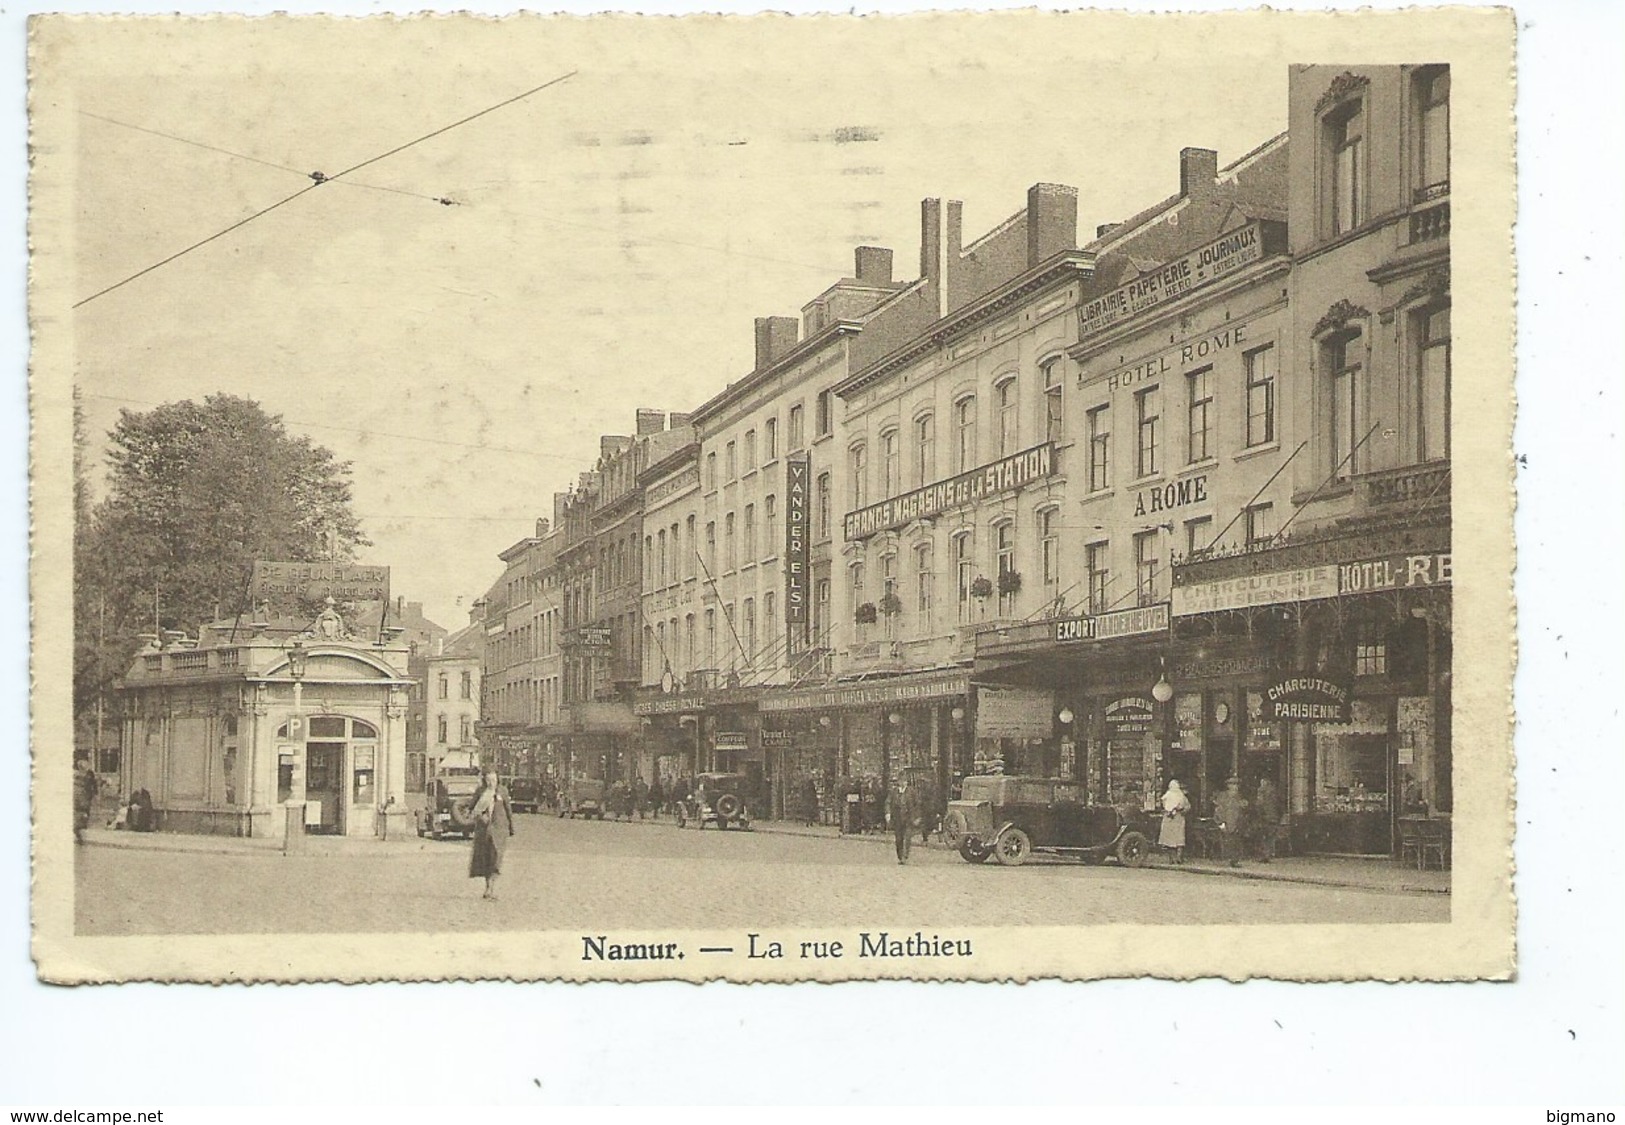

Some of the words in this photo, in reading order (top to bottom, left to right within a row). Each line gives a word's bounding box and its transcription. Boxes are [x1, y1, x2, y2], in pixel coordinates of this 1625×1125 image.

[1080, 290, 1127, 323] LIBRAIRIE
[1129, 259, 1191, 301] PAPETERIE
[1196, 227, 1256, 269] JOURNAUX
[1106, 357, 1171, 392] HOTEL
[1180, 325, 1247, 365] ROME
[791, 467, 803, 552] VANDER
[846, 505, 890, 538] GRANDS
[893, 479, 954, 522] MAGASINS
[956, 481, 968, 503] DE
[971, 475, 984, 498] LA
[985, 445, 1051, 494] STATION
[1133, 491, 1146, 517] A
[1150, 475, 1207, 513] ROME
[791, 563, 802, 617] ELST
[1183, 568, 1329, 600] CHARCUTERIE
[1186, 581, 1324, 613] PARISIENNE
[1057, 618, 1095, 640] EXPORT
[1267, 678, 1347, 703] CHARCUTERIE
[291, 718, 301, 737] P
[1275, 702, 1342, 718] PARISIENNE
